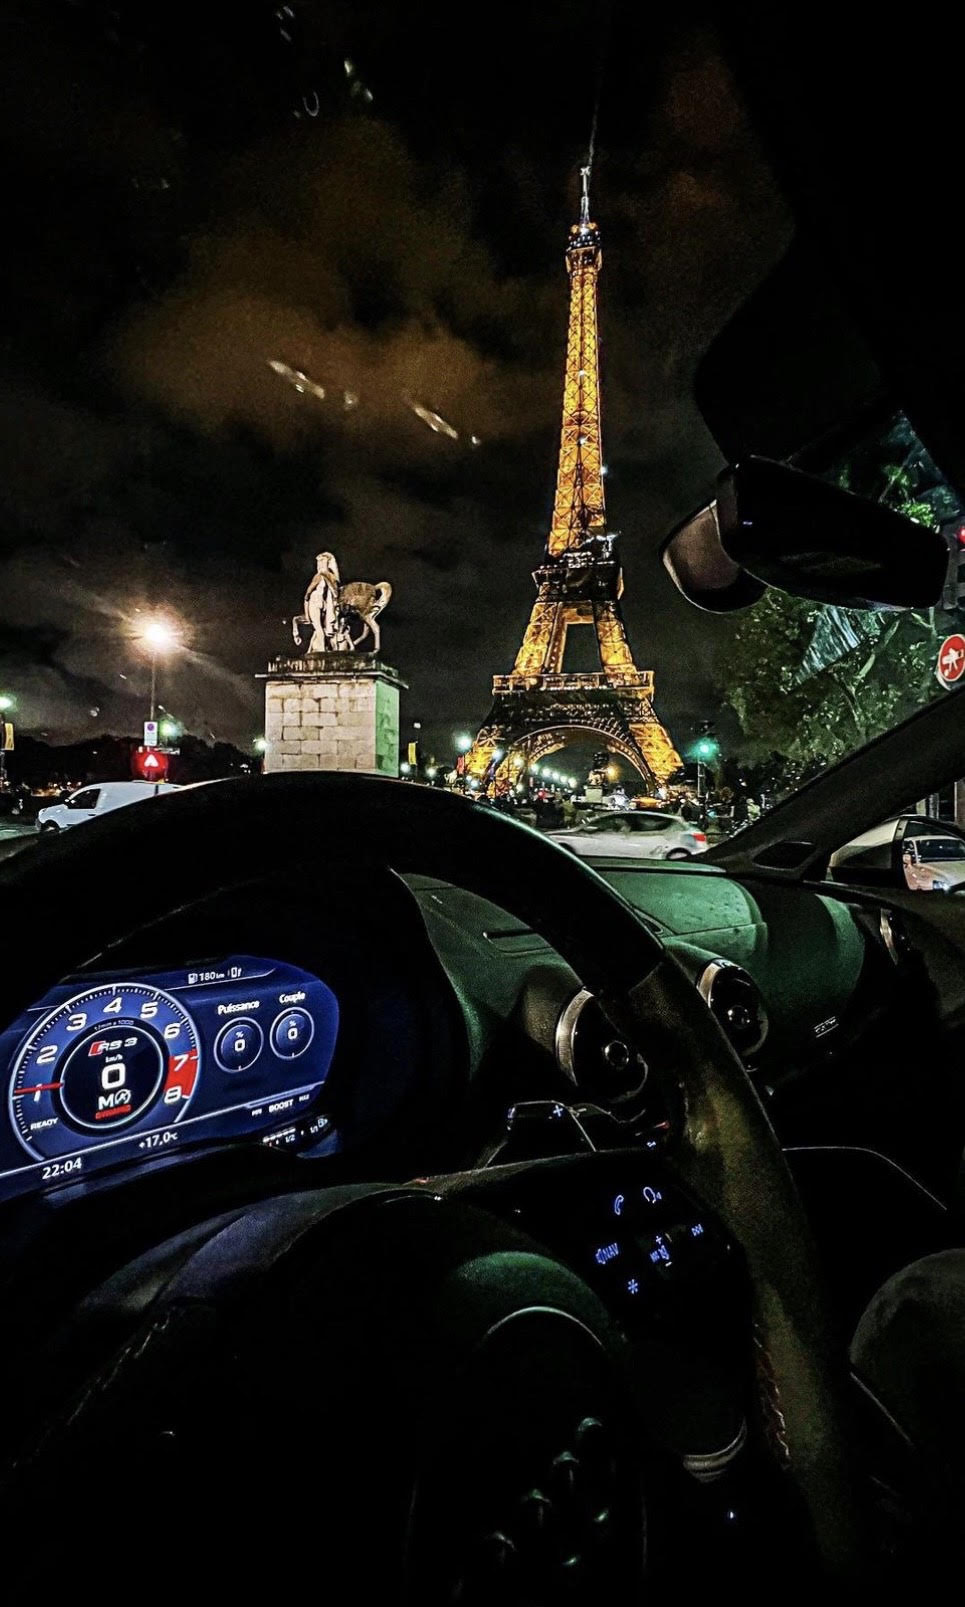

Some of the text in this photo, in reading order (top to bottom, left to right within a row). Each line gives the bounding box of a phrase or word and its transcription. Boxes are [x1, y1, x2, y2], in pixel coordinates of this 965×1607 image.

[103, 997, 123, 1013] 4
[279, 991, 305, 1004] Couple
[140, 1001, 158, 1019] 5
[218, 1000, 260, 1015] Puissance
[66, 1013, 87, 1031] 3
[164, 1022, 181, 1039] 6
[287, 1027, 298, 1040] 0
[234, 1038, 246, 1052] 0
[36, 1045, 58, 1064] 2
[174, 1054, 189, 1071] 7
[101, 1063, 126, 1089] 0
[34, 1083, 43, 1102] 1
[164, 1086, 182, 1104] 8
[269, 1098, 294, 1113] BOOST
[30, 1117, 59, 1130] READY
[42, 1158, 82, 1180] 22:04
